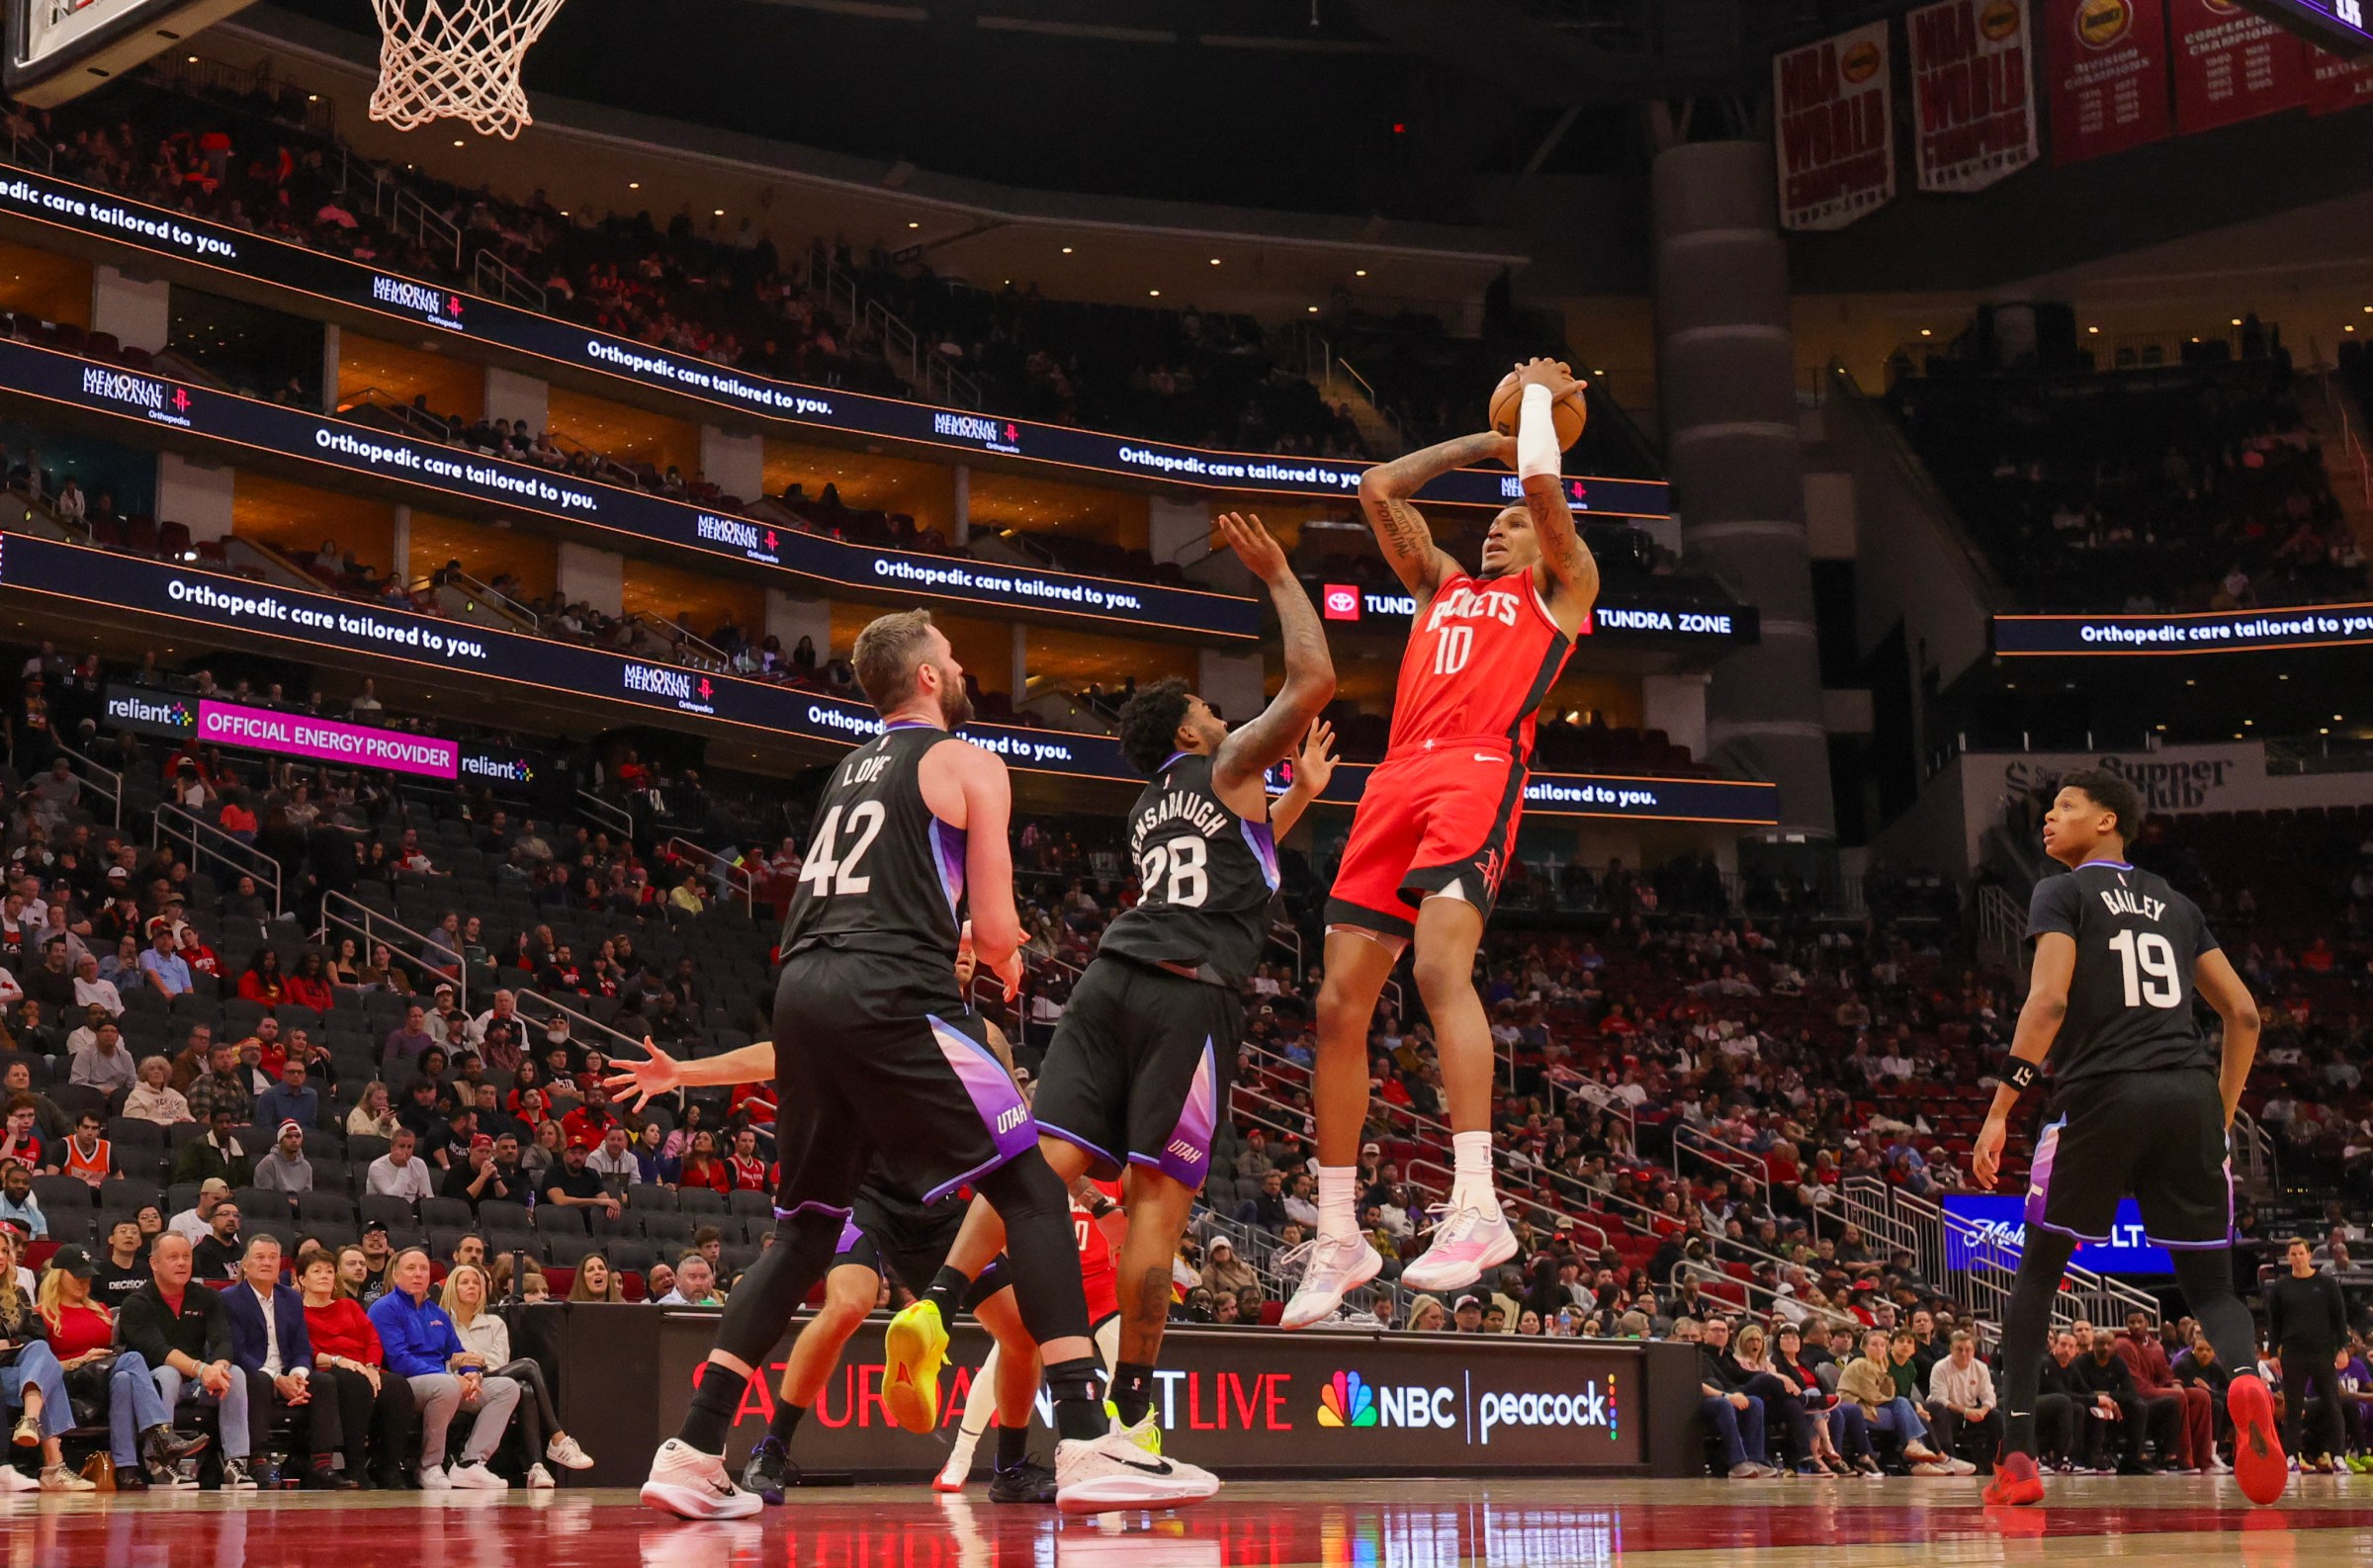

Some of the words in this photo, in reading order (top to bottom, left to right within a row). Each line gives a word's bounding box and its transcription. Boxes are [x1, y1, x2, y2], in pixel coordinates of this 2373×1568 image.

[43, 193, 86, 217] care
[89, 202, 169, 239] tailored
[172, 225, 194, 245] to
[196, 234, 237, 258] you.
[374, 276, 439, 305] MEMORIAL
[374, 286, 439, 314] HERMANN
[427, 314, 464, 330] Orthopedics
[83, 367, 163, 397] MEMORIAL
[587, 340, 675, 379] Orthopedic
[677, 369, 710, 388] care
[712, 375, 772, 405] tailored
[774, 392, 793, 408] to
[796, 397, 833, 415] you.
[83, 378, 162, 409] HERMANN
[148, 409, 190, 426] Orthopedics
[934, 413, 997, 432] MEMORIAL
[934, 423, 997, 442] HERMANN
[315, 428, 420, 470] Orthopedic
[423, 456, 463, 479] care
[466, 464, 537, 496] tailored
[540, 482, 558, 501] to
[561, 489, 597, 510] you.
[1118, 446, 1206, 473] Orthopedic
[1208, 462, 1245, 478] care
[1247, 465, 1316, 482] tailored
[1319, 470, 1338, 484] to
[1340, 473, 1361, 488] yo
[697, 514, 757, 539] MEMORIAL
[697, 525, 757, 550] HERMANN
[747, 550, 779, 564] Orthopedics
[874, 559, 972, 586] Orthopedic
[975, 574, 1012, 592] care
[1014, 577, 1083, 602] tailored
[1085, 587, 1103, 604] to
[1105, 593, 1141, 609] you.
[167, 579, 287, 621] Orthopedic
[291, 607, 334, 630] care
[338, 613, 418, 646] tailored
[421, 630, 443, 651] to
[446, 637, 486, 658] you.
[1364, 595, 1417, 615] TUND
[1425, 586, 1521, 633] RCKETS
[1597, 609, 1672, 632] TUNDRA
[1679, 613, 1731, 634] ZONE
[2080, 625, 2185, 645] Orthopedic
[2189, 625, 2231, 641] care
[2234, 616, 2315, 638] tailored
[2318, 615, 2339, 633] to
[1434, 625, 1473, 675] 10
[624, 674, 690, 699] HERMANN
[625, 663, 690, 688] MEMORIAL
[109, 698, 171, 725] reliant
[678, 700, 714, 714] Orthopedics
[207, 712, 291, 742] OFFICIAL
[295, 727, 365, 754] ENERGY
[366, 739, 450, 767] PROVIDER
[808, 705, 887, 736] Orthoped
[1011, 739, 1031, 756] to
[1034, 743, 1072, 761] you.
[462, 755, 516, 780] reliant
[842, 755, 892, 787] LOVE
[1597, 788, 1616, 805] to
[1620, 790, 1657, 808] you.
[2144, 781, 2204, 810] lub
[1132, 790, 1228, 866] SENSABAUGH
[799, 800, 886, 897] 42
[1137, 834, 1208, 909] 28
[2100, 888, 2166, 921] BAILEY
[2109, 928, 2181, 1008] 19
[2012, 1066, 2034, 1087] 19
[997, 1103, 1027, 1135] UTAH
[1167, 1139, 1202, 1165] UTAH
[1964, 1218, 2025, 1249] Mich
[1188, 1372, 1292, 1431] LIVE
[1380, 1386, 1456, 1429] NBC
[1480, 1380, 1607, 1444] peacock
